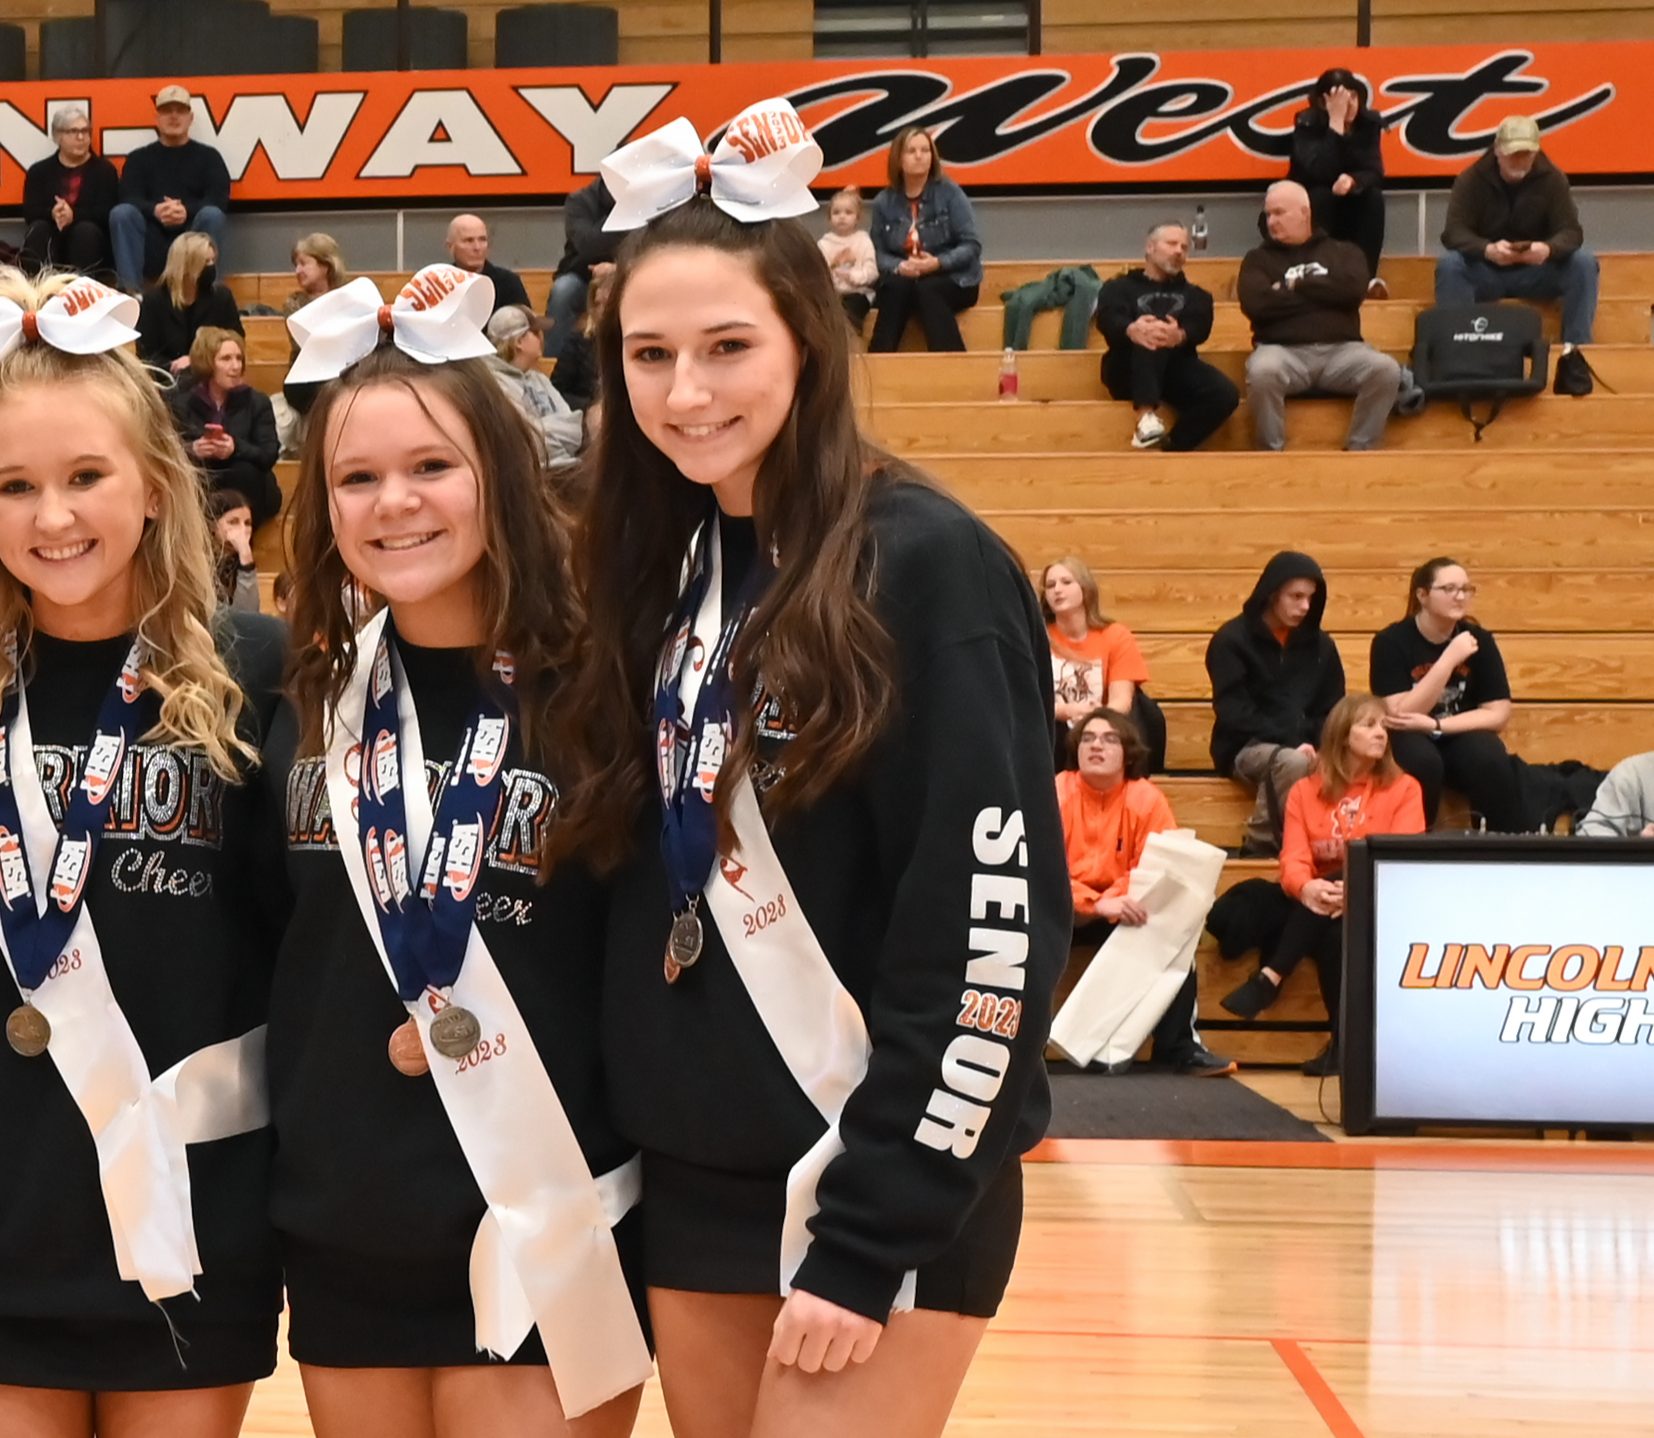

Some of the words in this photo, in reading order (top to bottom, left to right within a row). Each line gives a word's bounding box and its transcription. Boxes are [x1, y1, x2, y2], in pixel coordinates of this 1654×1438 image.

[79, 735, 122, 796] IHSA
[376, 733, 400, 796] IHSA
[466, 717, 505, 778] IHSA
[50, 840, 88, 903] IHSA
[443, 823, 479, 892] IHSA
[742, 893, 788, 938] 2023
[47, 948, 82, 980] 023
